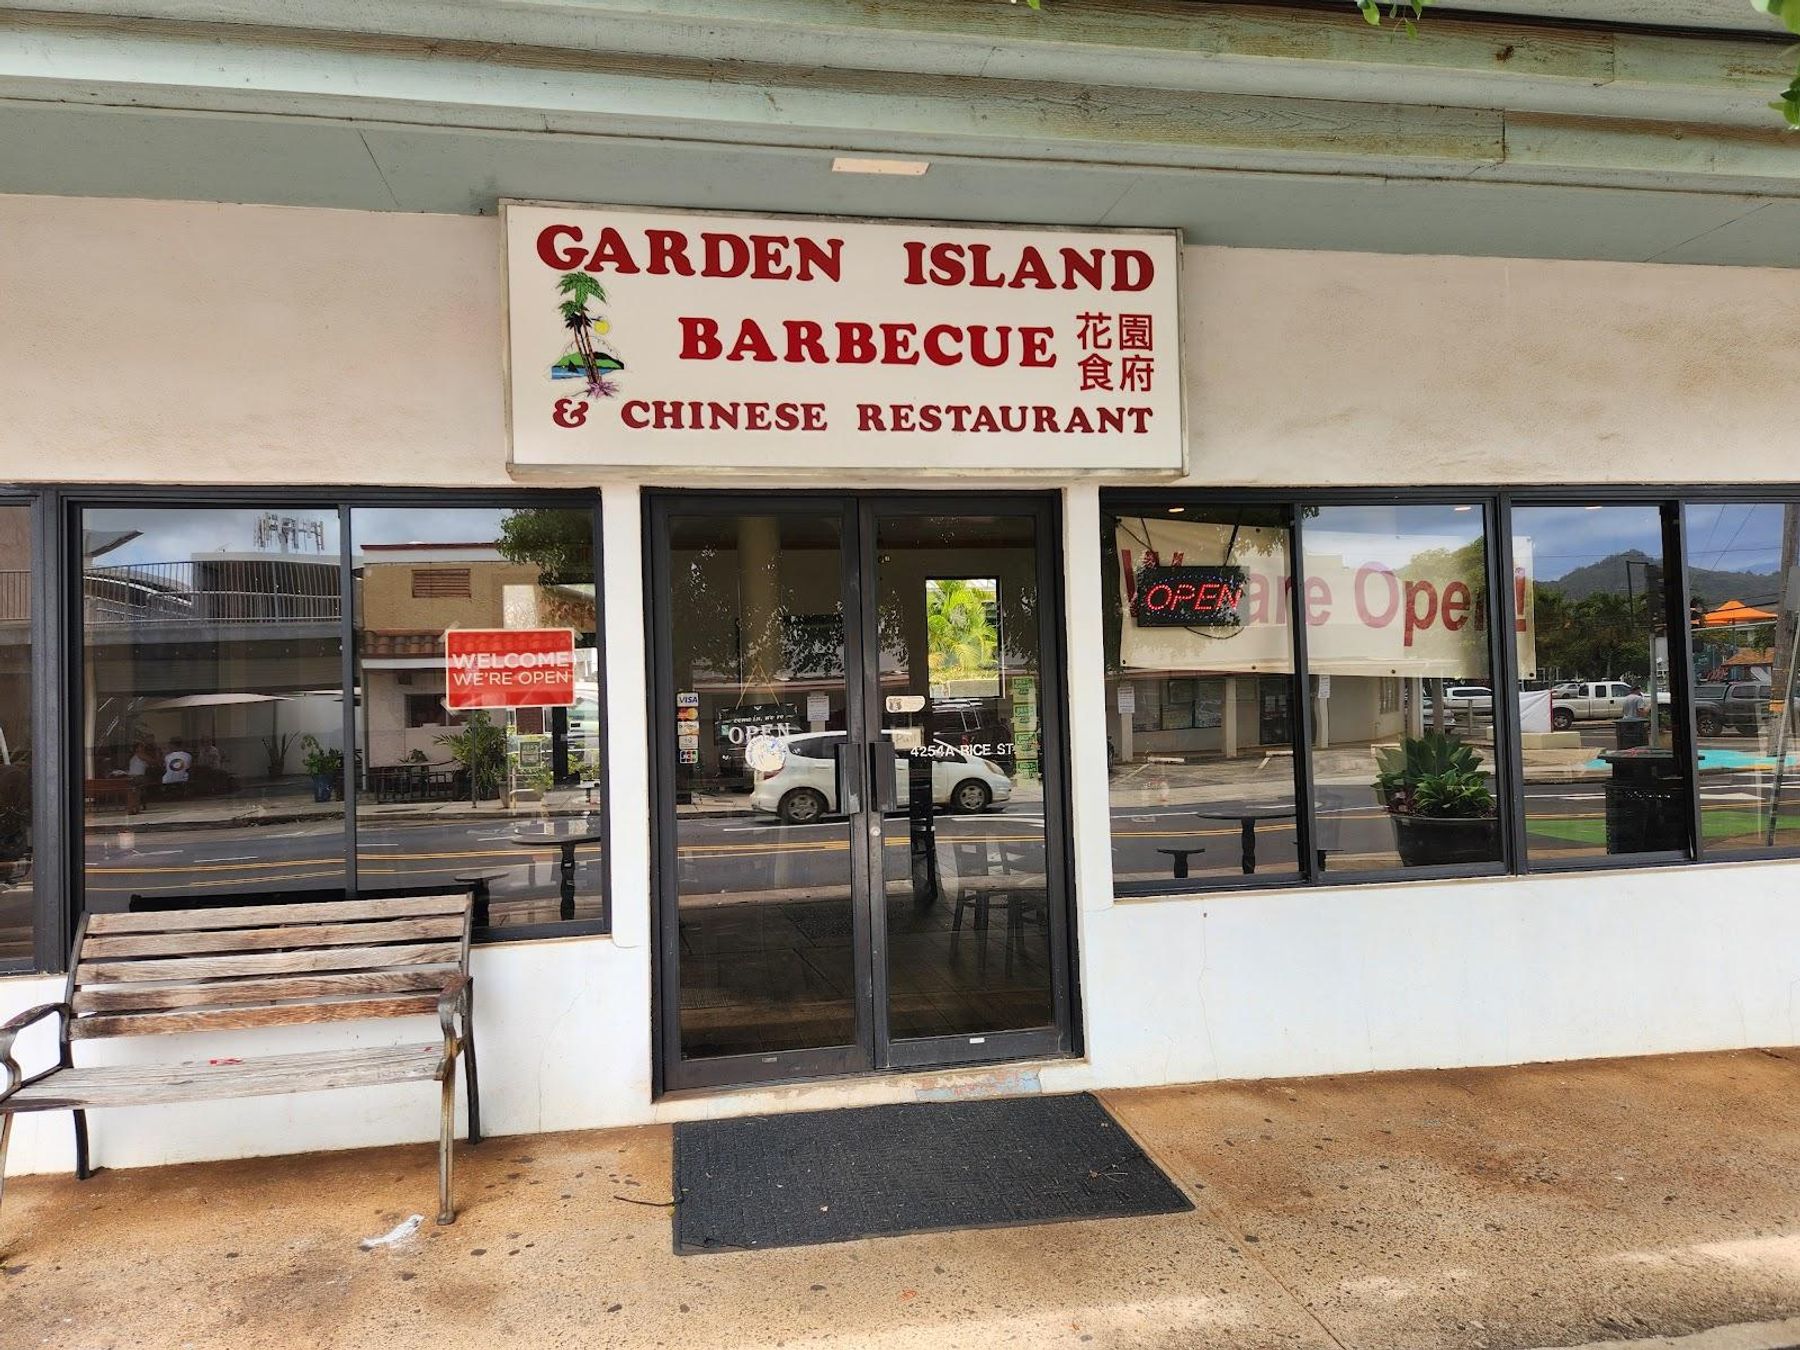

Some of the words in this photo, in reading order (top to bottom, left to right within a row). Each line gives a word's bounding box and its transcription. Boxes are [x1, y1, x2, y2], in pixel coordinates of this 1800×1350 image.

[536, 224, 845, 282] GARDEN
[903, 241, 1155, 291] ISLAND
[678, 317, 1057, 368] BARBECUE
[1075, 311, 1153, 351] 花園
[1077, 353, 1154, 392] 食府
[552, 398, 589, 428] &
[620, 400, 828, 431] CHINESE
[856, 403, 1154, 433] RESTAURANT
[1146, 583, 1242, 611] OPEN
[452, 651, 570, 669] WELCOME
[453, 672, 513, 686] WE'RE
[518, 670, 569, 685] OPEN
[728, 723, 790, 744] OPEN
[910, 744, 955, 757] 4254A
[960, 744, 991, 756] RICE
